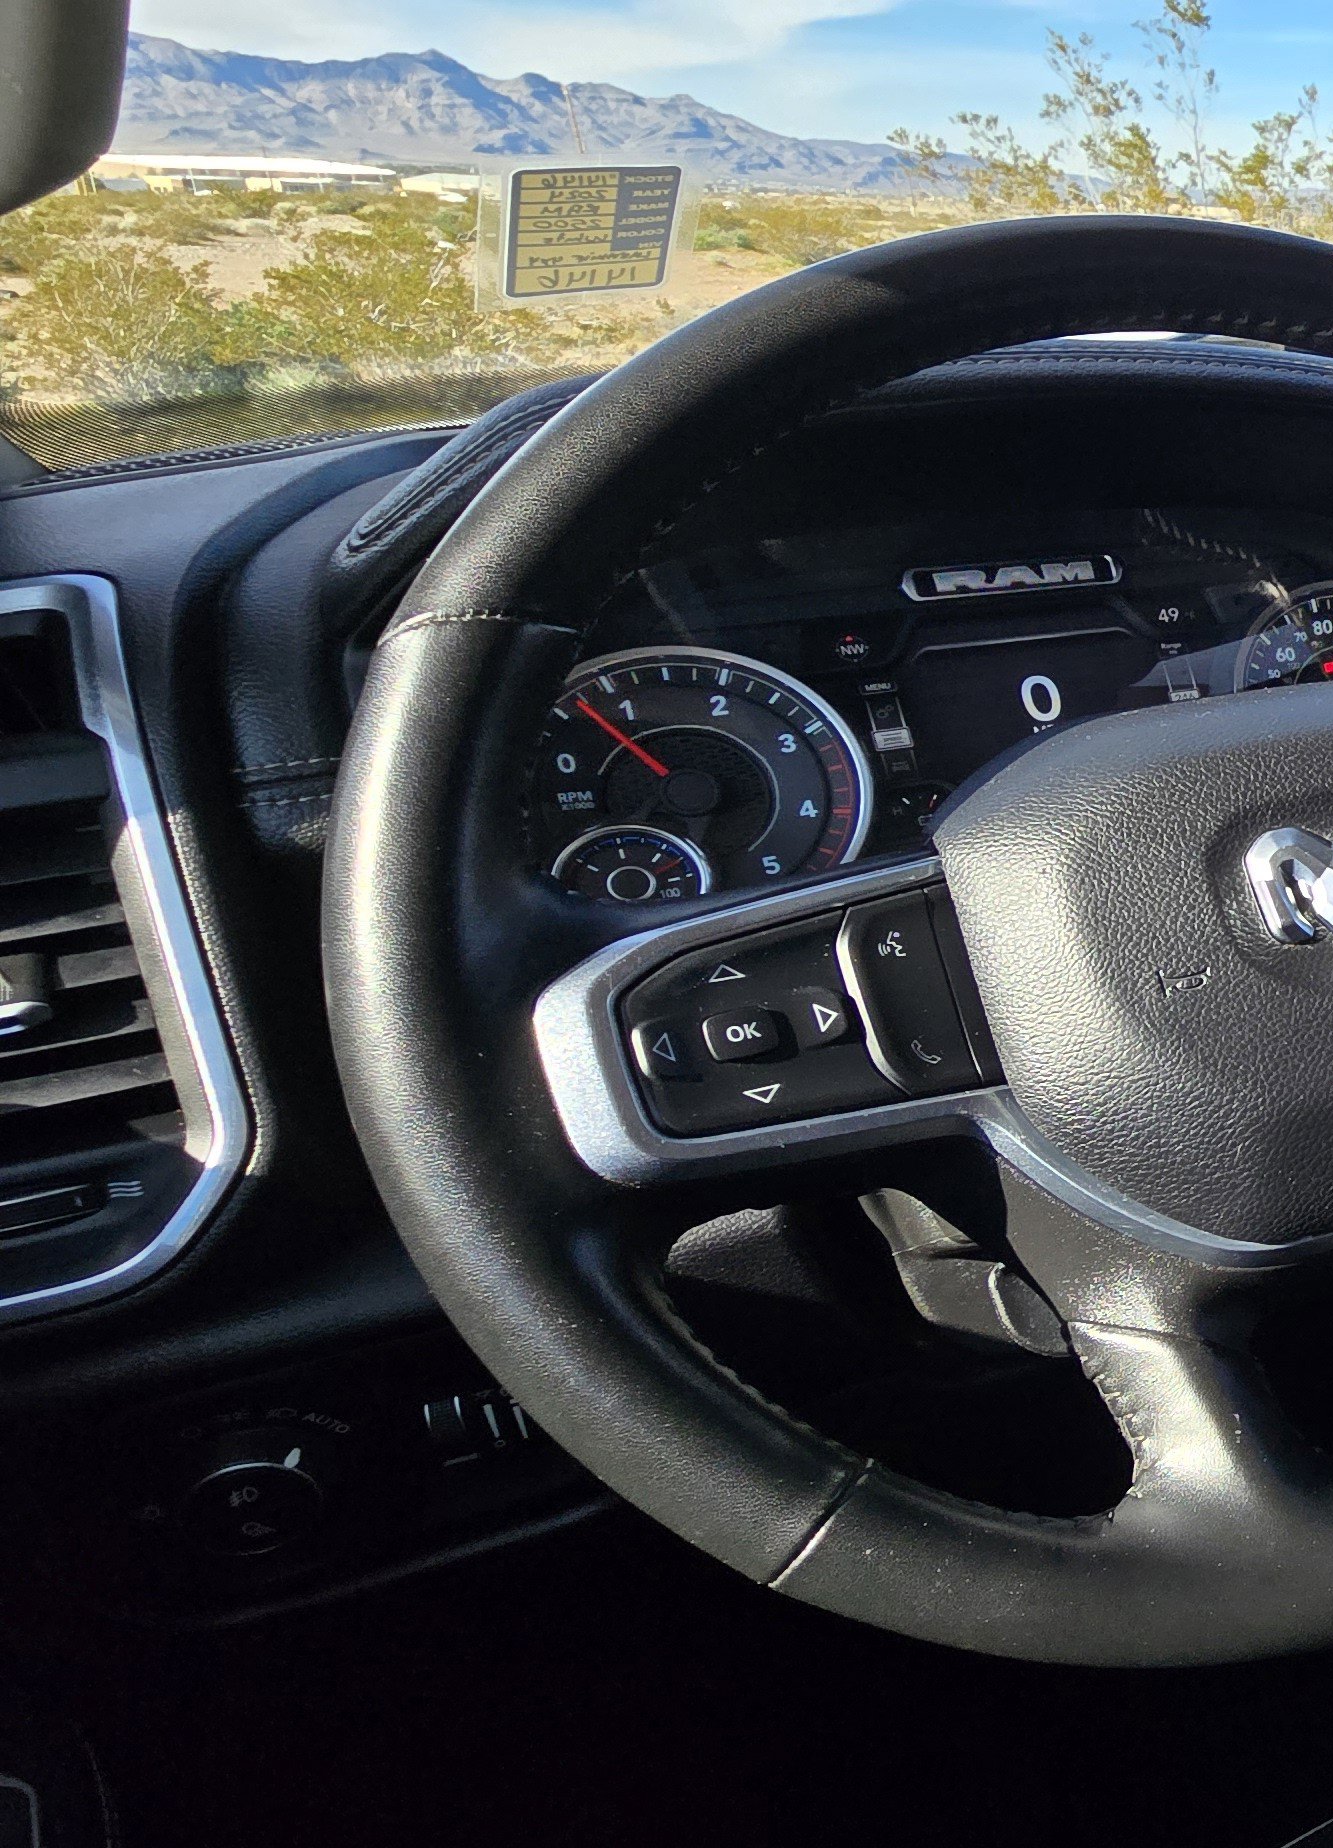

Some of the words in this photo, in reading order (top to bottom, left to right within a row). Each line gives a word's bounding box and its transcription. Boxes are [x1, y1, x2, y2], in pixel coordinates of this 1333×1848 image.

[932, 560, 1096, 592] RAM
[1158, 607, 1180, 623] 49
[1294, 631, 1309, 643] 70
[1311, 619, 1333, 637] 80
[840, 643, 866, 656] NW
[1275, 647, 1297, 663] 60
[1267, 668, 1282, 680] 50
[864, 682, 892, 692] MENU
[709, 695, 730, 717] 2
[1020, 675, 1062, 722] 0
[618, 699, 636, 721] 1
[777, 734, 797, 754] 3
[556, 752, 577, 775] 0
[556, 790, 594, 804] RPM
[798, 799, 818, 819] 4
[762, 856, 781, 876] 5
[658, 887, 682, 900] 100
[725, 1022, 762, 1043] OK
[302, 1411, 352, 1434] AUTO
